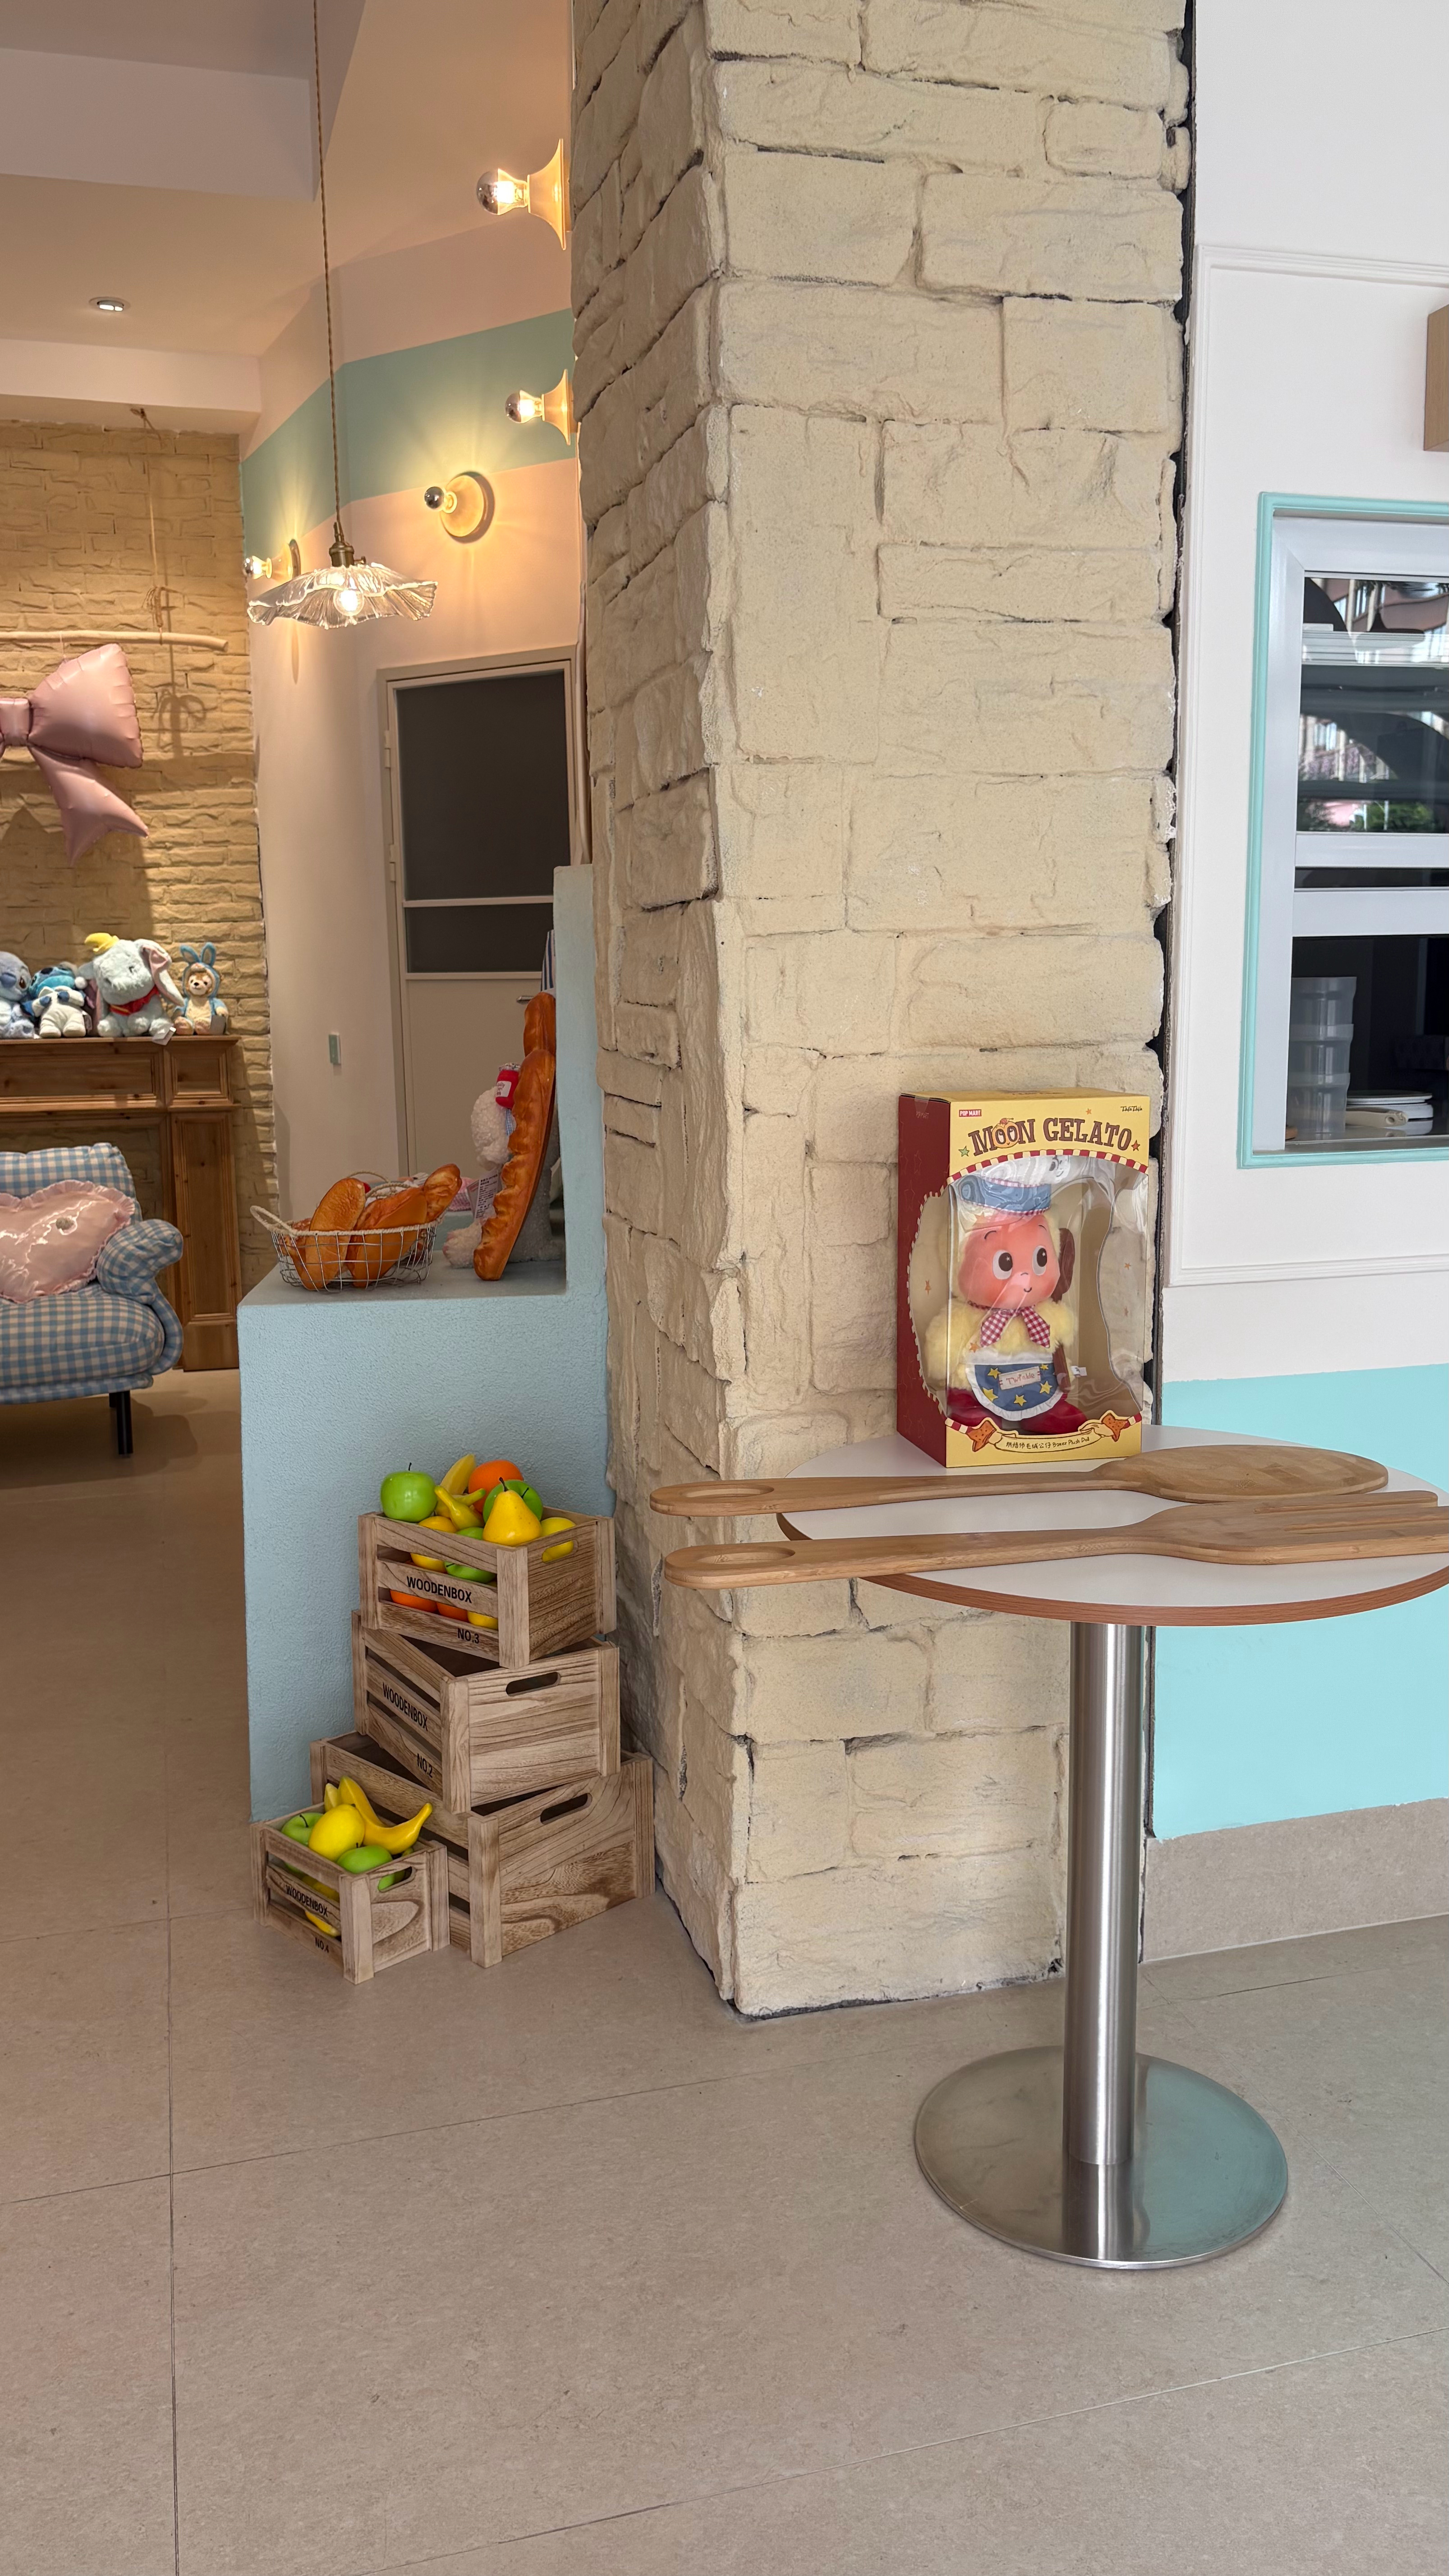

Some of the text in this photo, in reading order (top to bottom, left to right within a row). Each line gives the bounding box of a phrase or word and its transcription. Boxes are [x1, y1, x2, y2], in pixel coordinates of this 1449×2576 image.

[968, 1118, 1132, 1156] MOON GELATO
[407, 1575, 472, 1604] WOODENBOX
[458, 1628, 479, 1644] NO.3
[382, 1682, 428, 1732] WOODENBOX
[417, 1753, 433, 1778] NO.2
[286, 1885, 328, 1917] WOODENBOX
